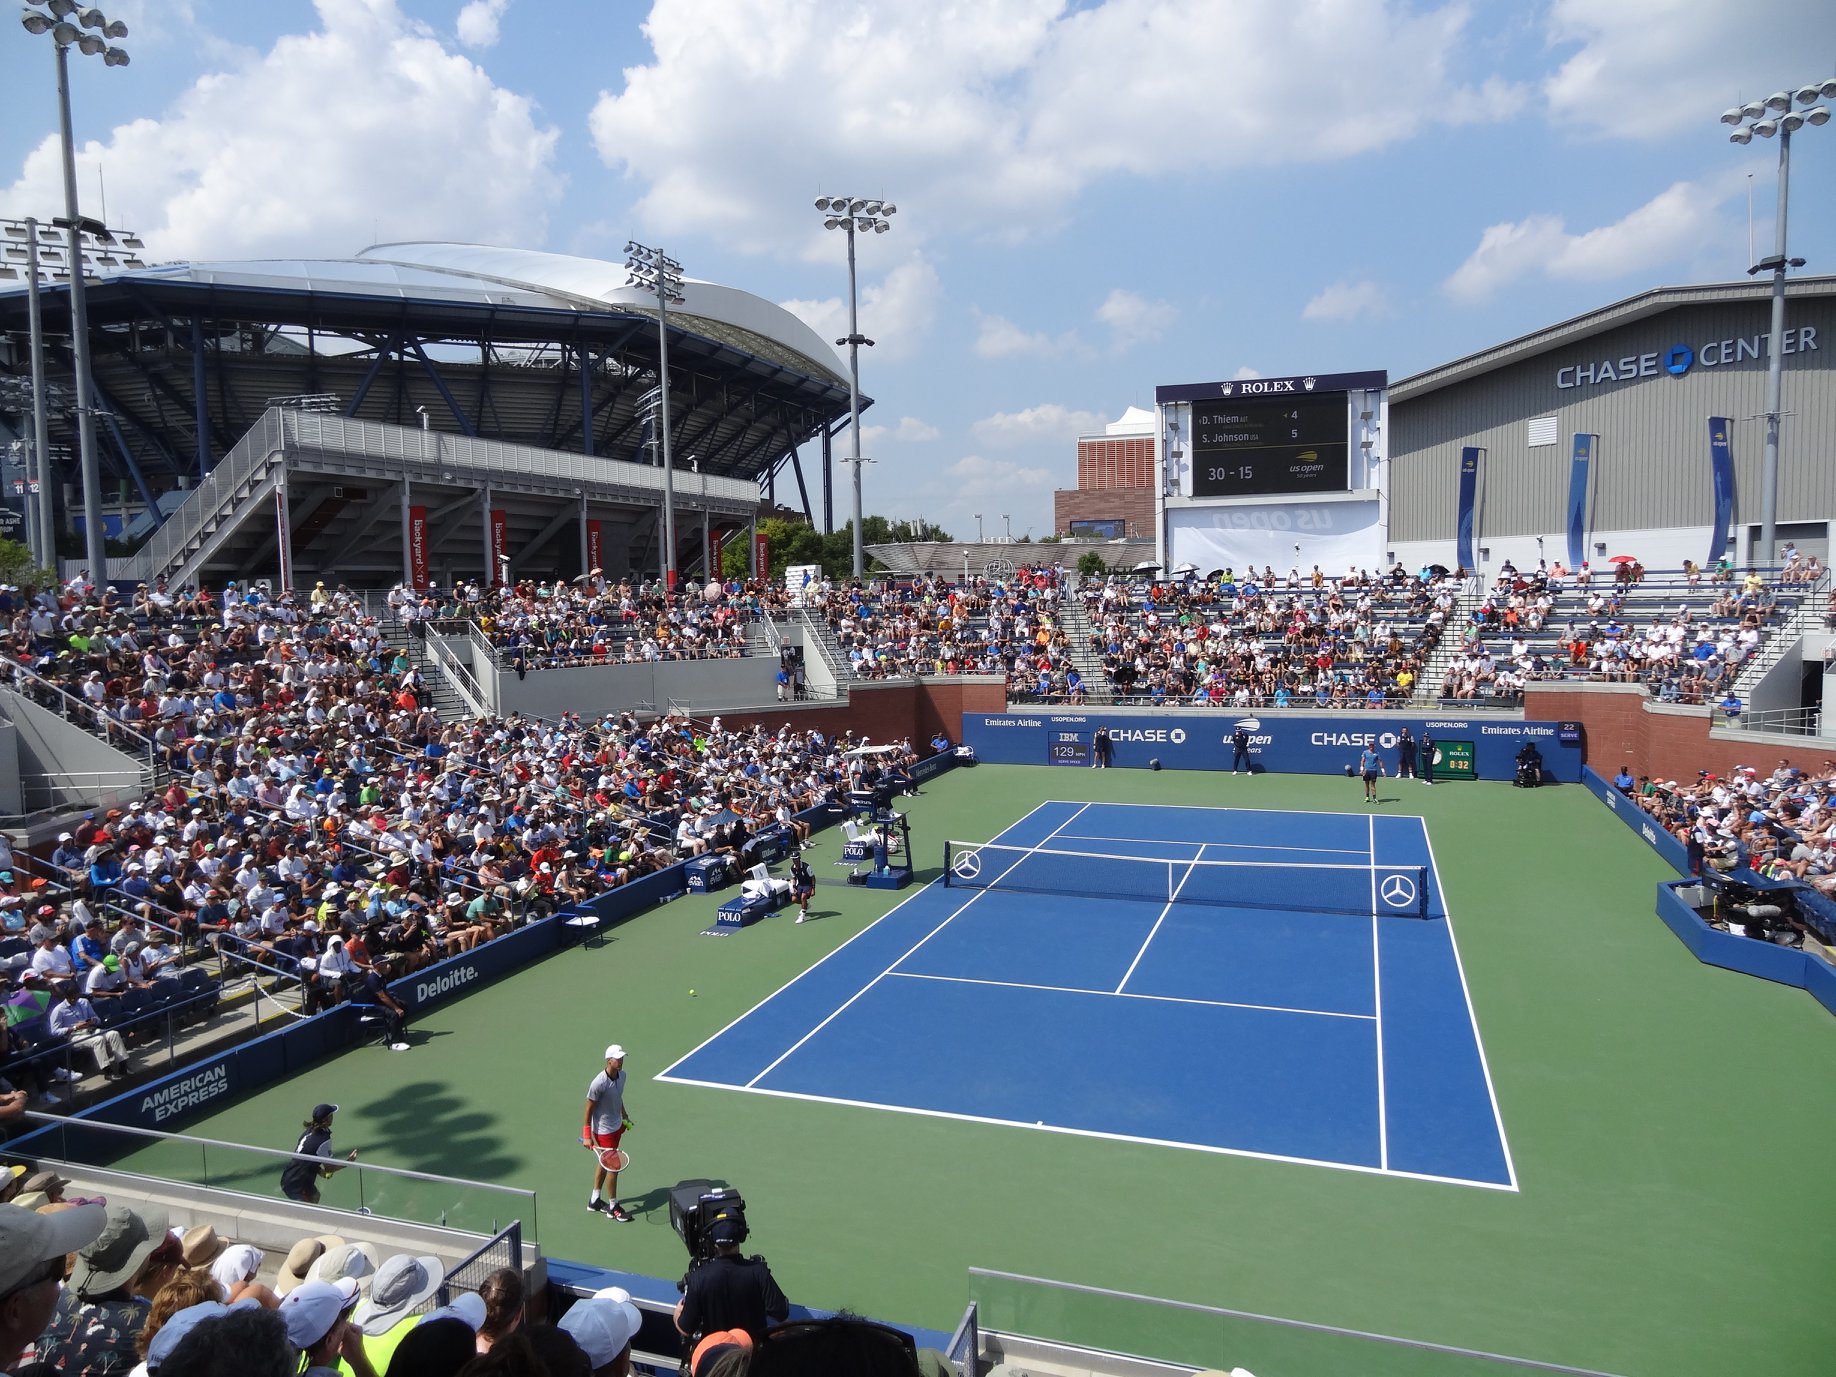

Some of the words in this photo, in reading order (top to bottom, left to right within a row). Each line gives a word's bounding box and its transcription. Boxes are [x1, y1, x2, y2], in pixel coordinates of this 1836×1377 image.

[1556, 352, 1659, 389] CHASE
[1700, 327, 1817, 366] CENTER
[1241, 380, 1295, 394] ROLEX
[1202, 416, 1210, 425] D.
[1213, 415, 1239, 424] Thiem
[1291, 410, 1298, 419] 4
[1202, 434, 1210, 443] S.
[1213, 433, 1249, 442] Johnson
[1291, 429, 1298, 438] 5
[1208, 467, 1225, 480] 30
[1239, 466, 1253, 479] 15
[1301, 464, 1324, 475] open
[15, 485, 24, 494] 11
[30, 483, 39, 493] 12
[413, 520, 423, 564] backyard
[985, 718, 1015, 727] Emirates
[1017, 719, 1042, 727] Airline
[1059, 733, 1079, 742] IBM
[1109, 729, 1167, 742] CHASE
[1481, 726, 1520, 735] Emirates
[1522, 727, 1554, 736] Airline
[1246, 735, 1272, 747] pen
[1311, 732, 1376, 746] CHASE
[1054, 746, 1074, 757] 129
[844, 847, 864, 856] POLO
[718, 911, 741, 922] POLO
[417, 966, 479, 1003] Deloitte.
[141, 1064, 226, 1113] AMERICAN
[154, 1077, 228, 1122] EXPRESS
